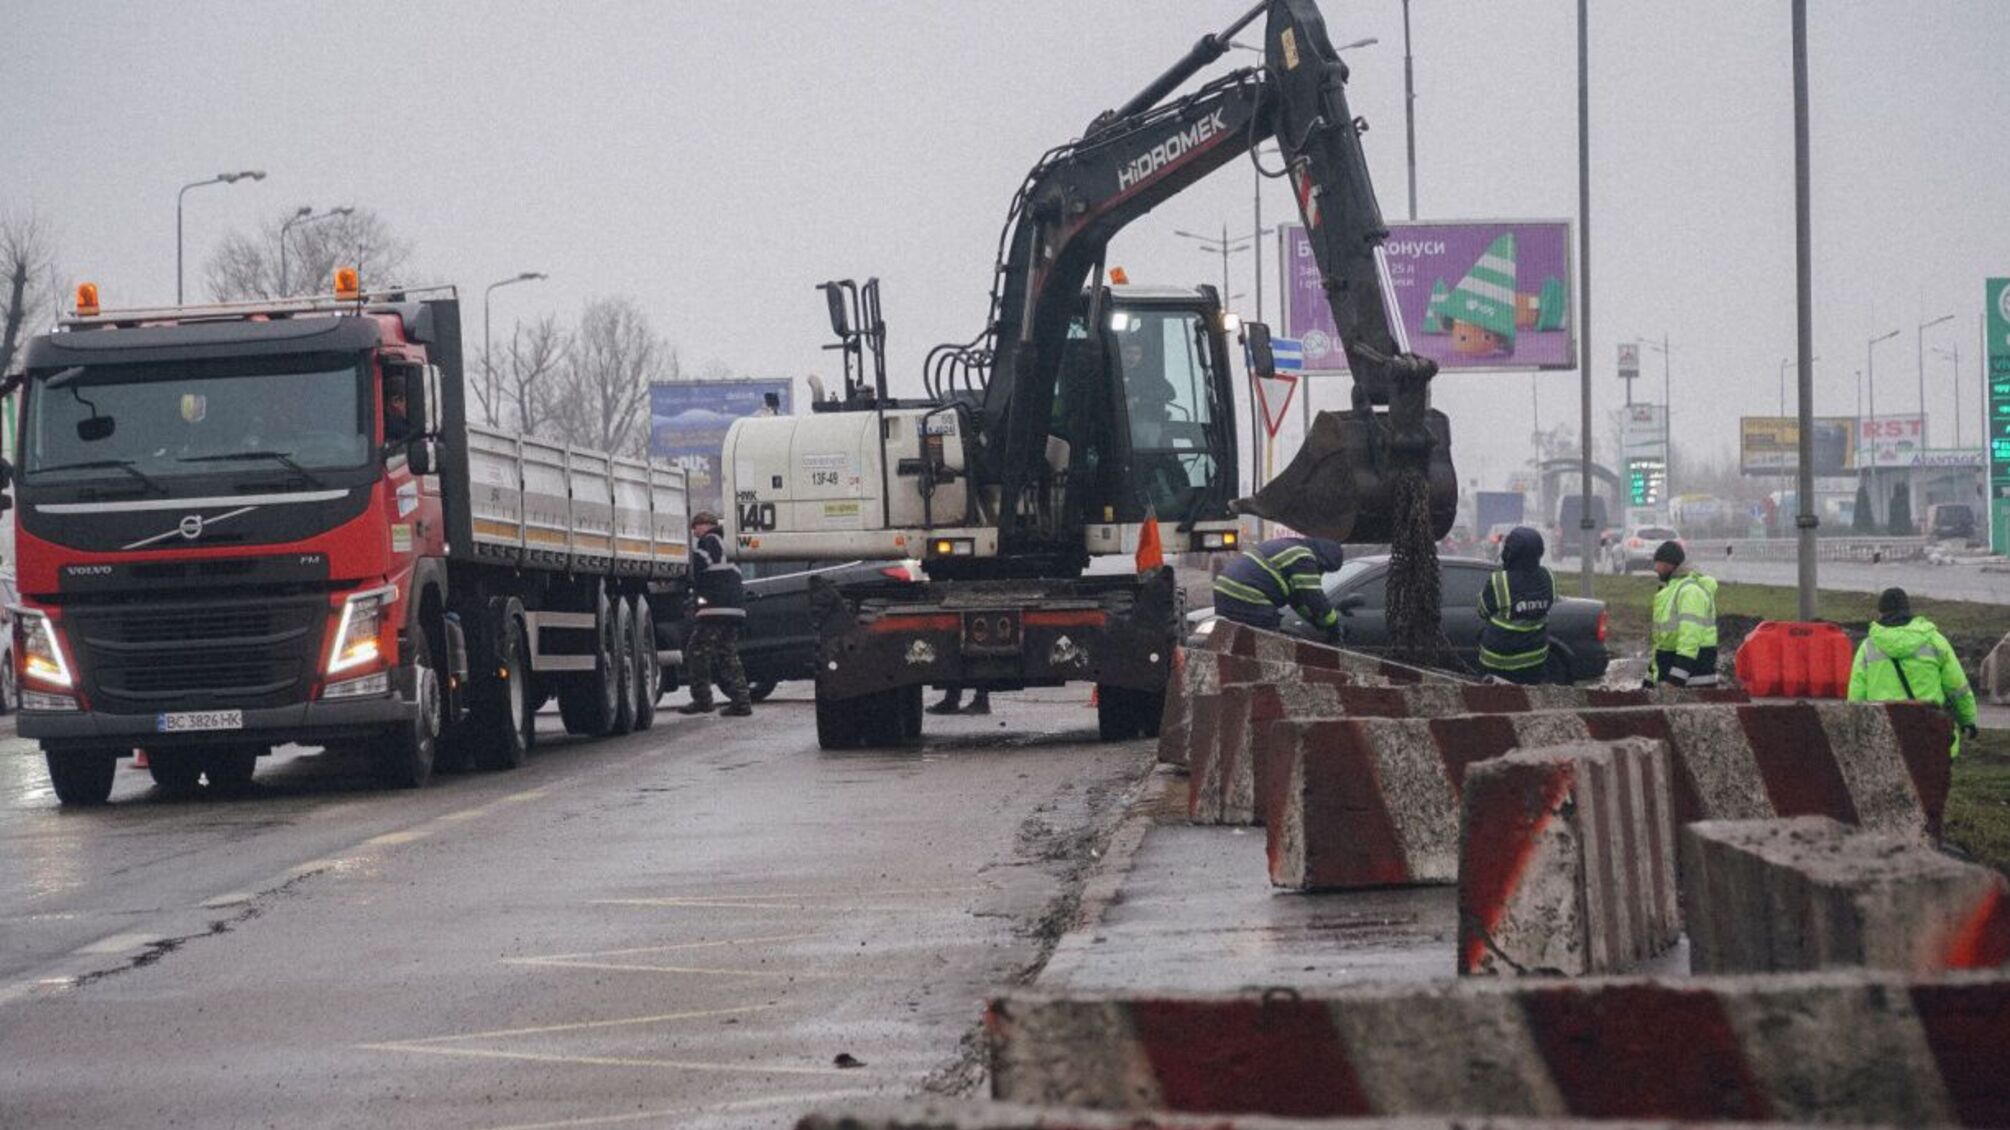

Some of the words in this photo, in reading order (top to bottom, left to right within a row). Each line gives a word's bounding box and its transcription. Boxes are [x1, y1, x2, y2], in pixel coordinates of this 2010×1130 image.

[1863, 420, 1921, 438] RST
[739, 502, 776, 531] 140
[300, 555, 320, 565] FM
[67, 566, 112, 575] VOLVO
[167, 715, 186, 729] BC
[189, 713, 218, 728] 3826
